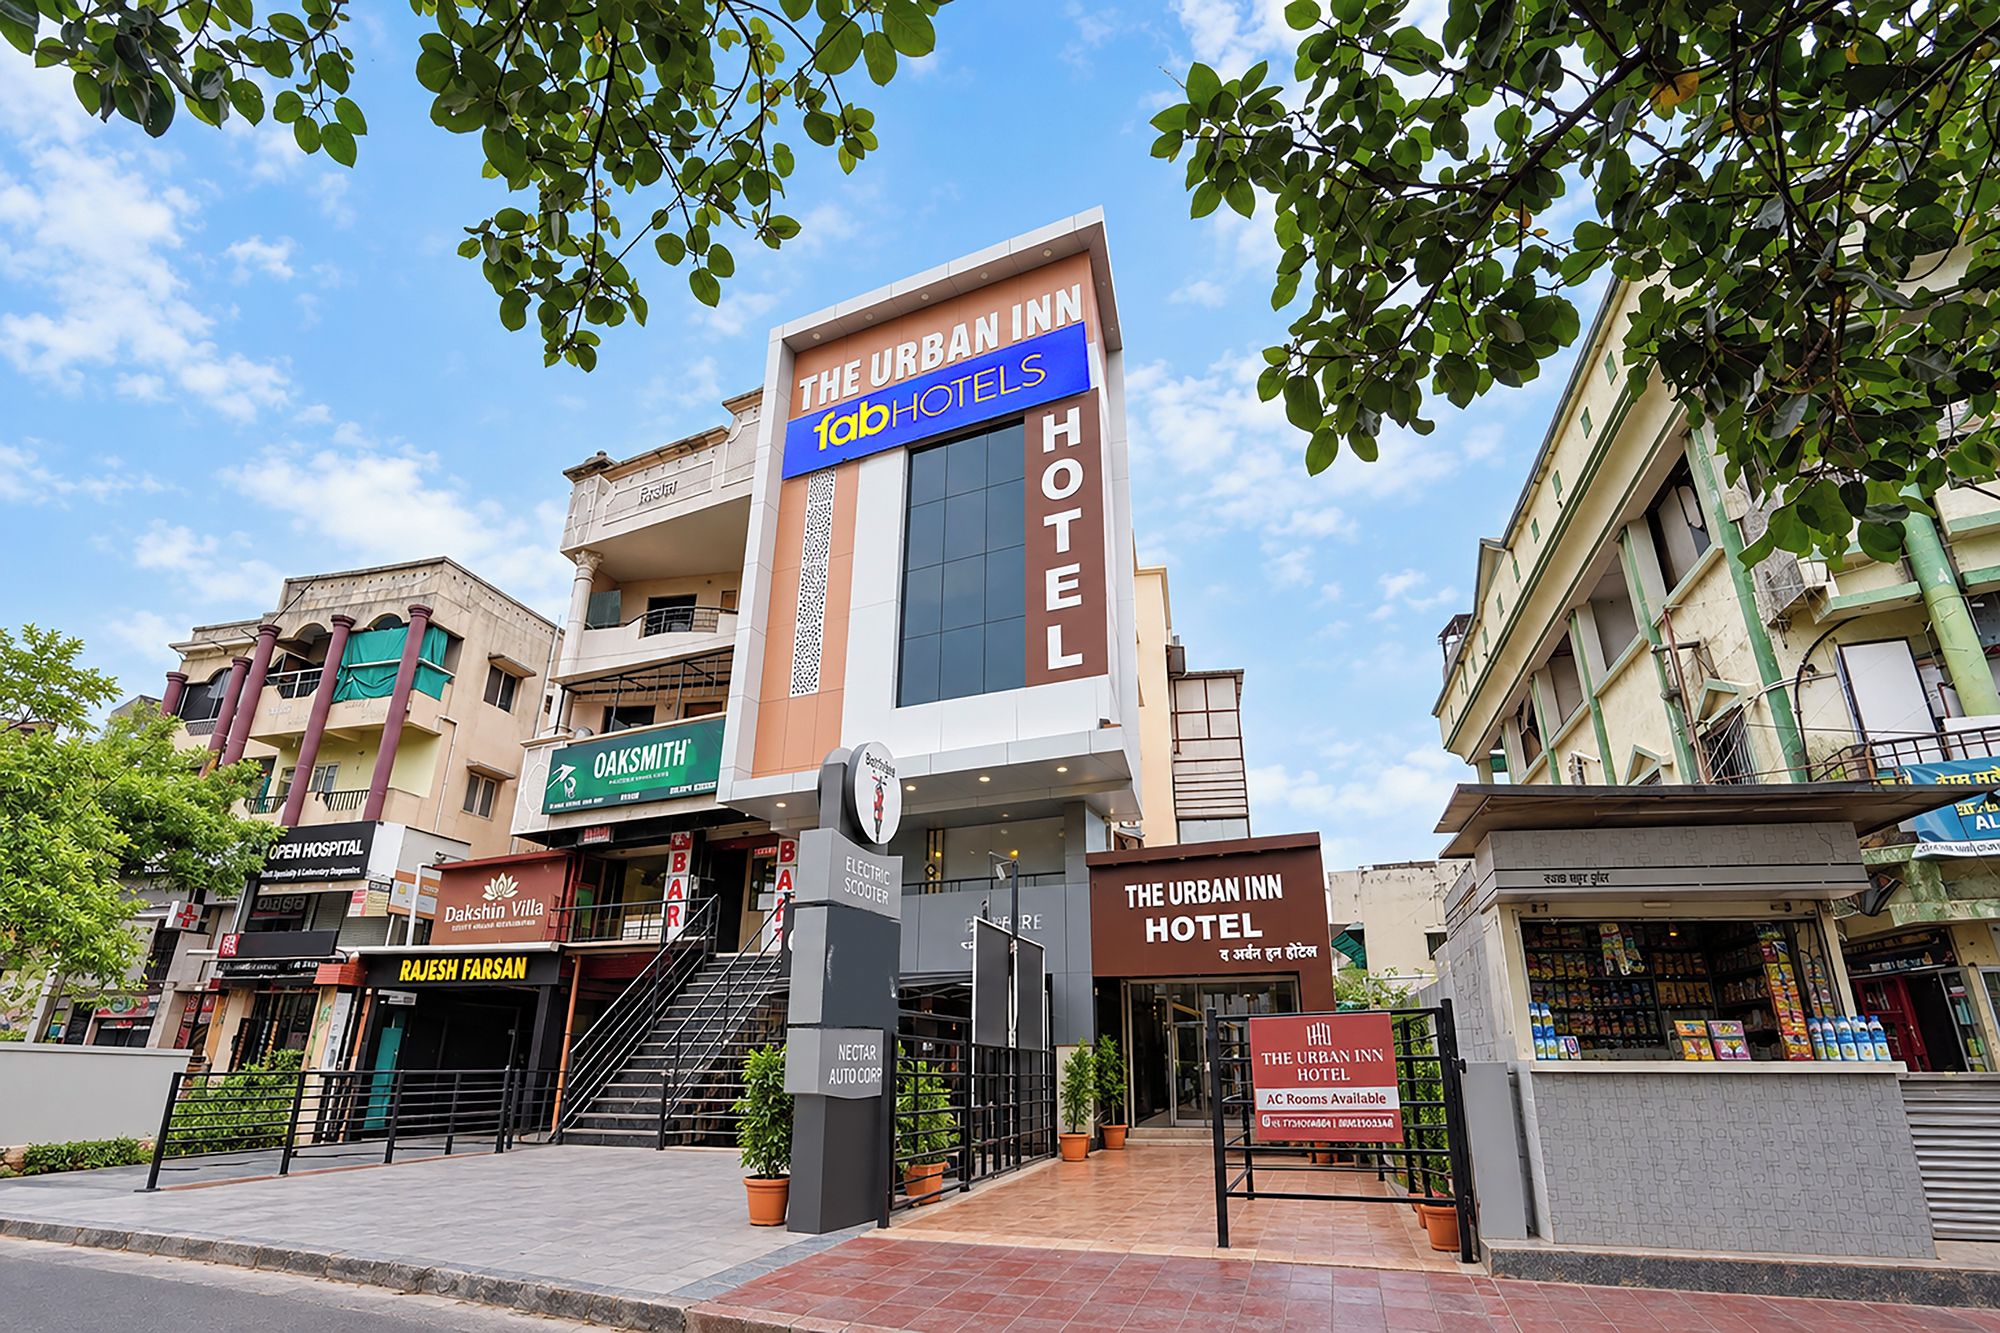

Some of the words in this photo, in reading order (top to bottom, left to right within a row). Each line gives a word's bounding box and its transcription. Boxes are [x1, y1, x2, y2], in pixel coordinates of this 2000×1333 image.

[799, 359, 861, 411] THE
[869, 311, 999, 388] URBAN
[1012, 283, 1083, 342] INN
[1041, 406, 1084, 671] HOTEL
[594, 739, 687, 779] OAKSMITH
[302, 840, 364, 859] HOSPITAL
[845, 857, 890, 885] ELECTRIC
[667, 852, 687, 928] BAR
[844, 877, 889, 905] SCOOTER
[1125, 884, 1164, 909] THE
[1169, 877, 1241, 906] URBAN
[1245, 873, 1283, 901] INN
[444, 902, 506, 923] Dakshin
[512, 898, 544, 918] Villa
[1145, 912, 1263, 943] HOTEL
[399, 958, 459, 981] RAJESH
[461, 957, 528, 980] FARSAN
[838, 1044, 876, 1062] NECTAR
[1261, 1052, 1293, 1065] THE
[1297, 1050, 1350, 1065] URBAN
[1354, 1048, 1384, 1063] INN
[829, 1069, 855, 1085] AUTO
[1297, 1068, 1351, 1081] HOTEL
[1266, 1094, 1283, 1105] AC
[1287, 1095, 1328, 1105] Rooms
[1331, 1092, 1387, 1105] Available
